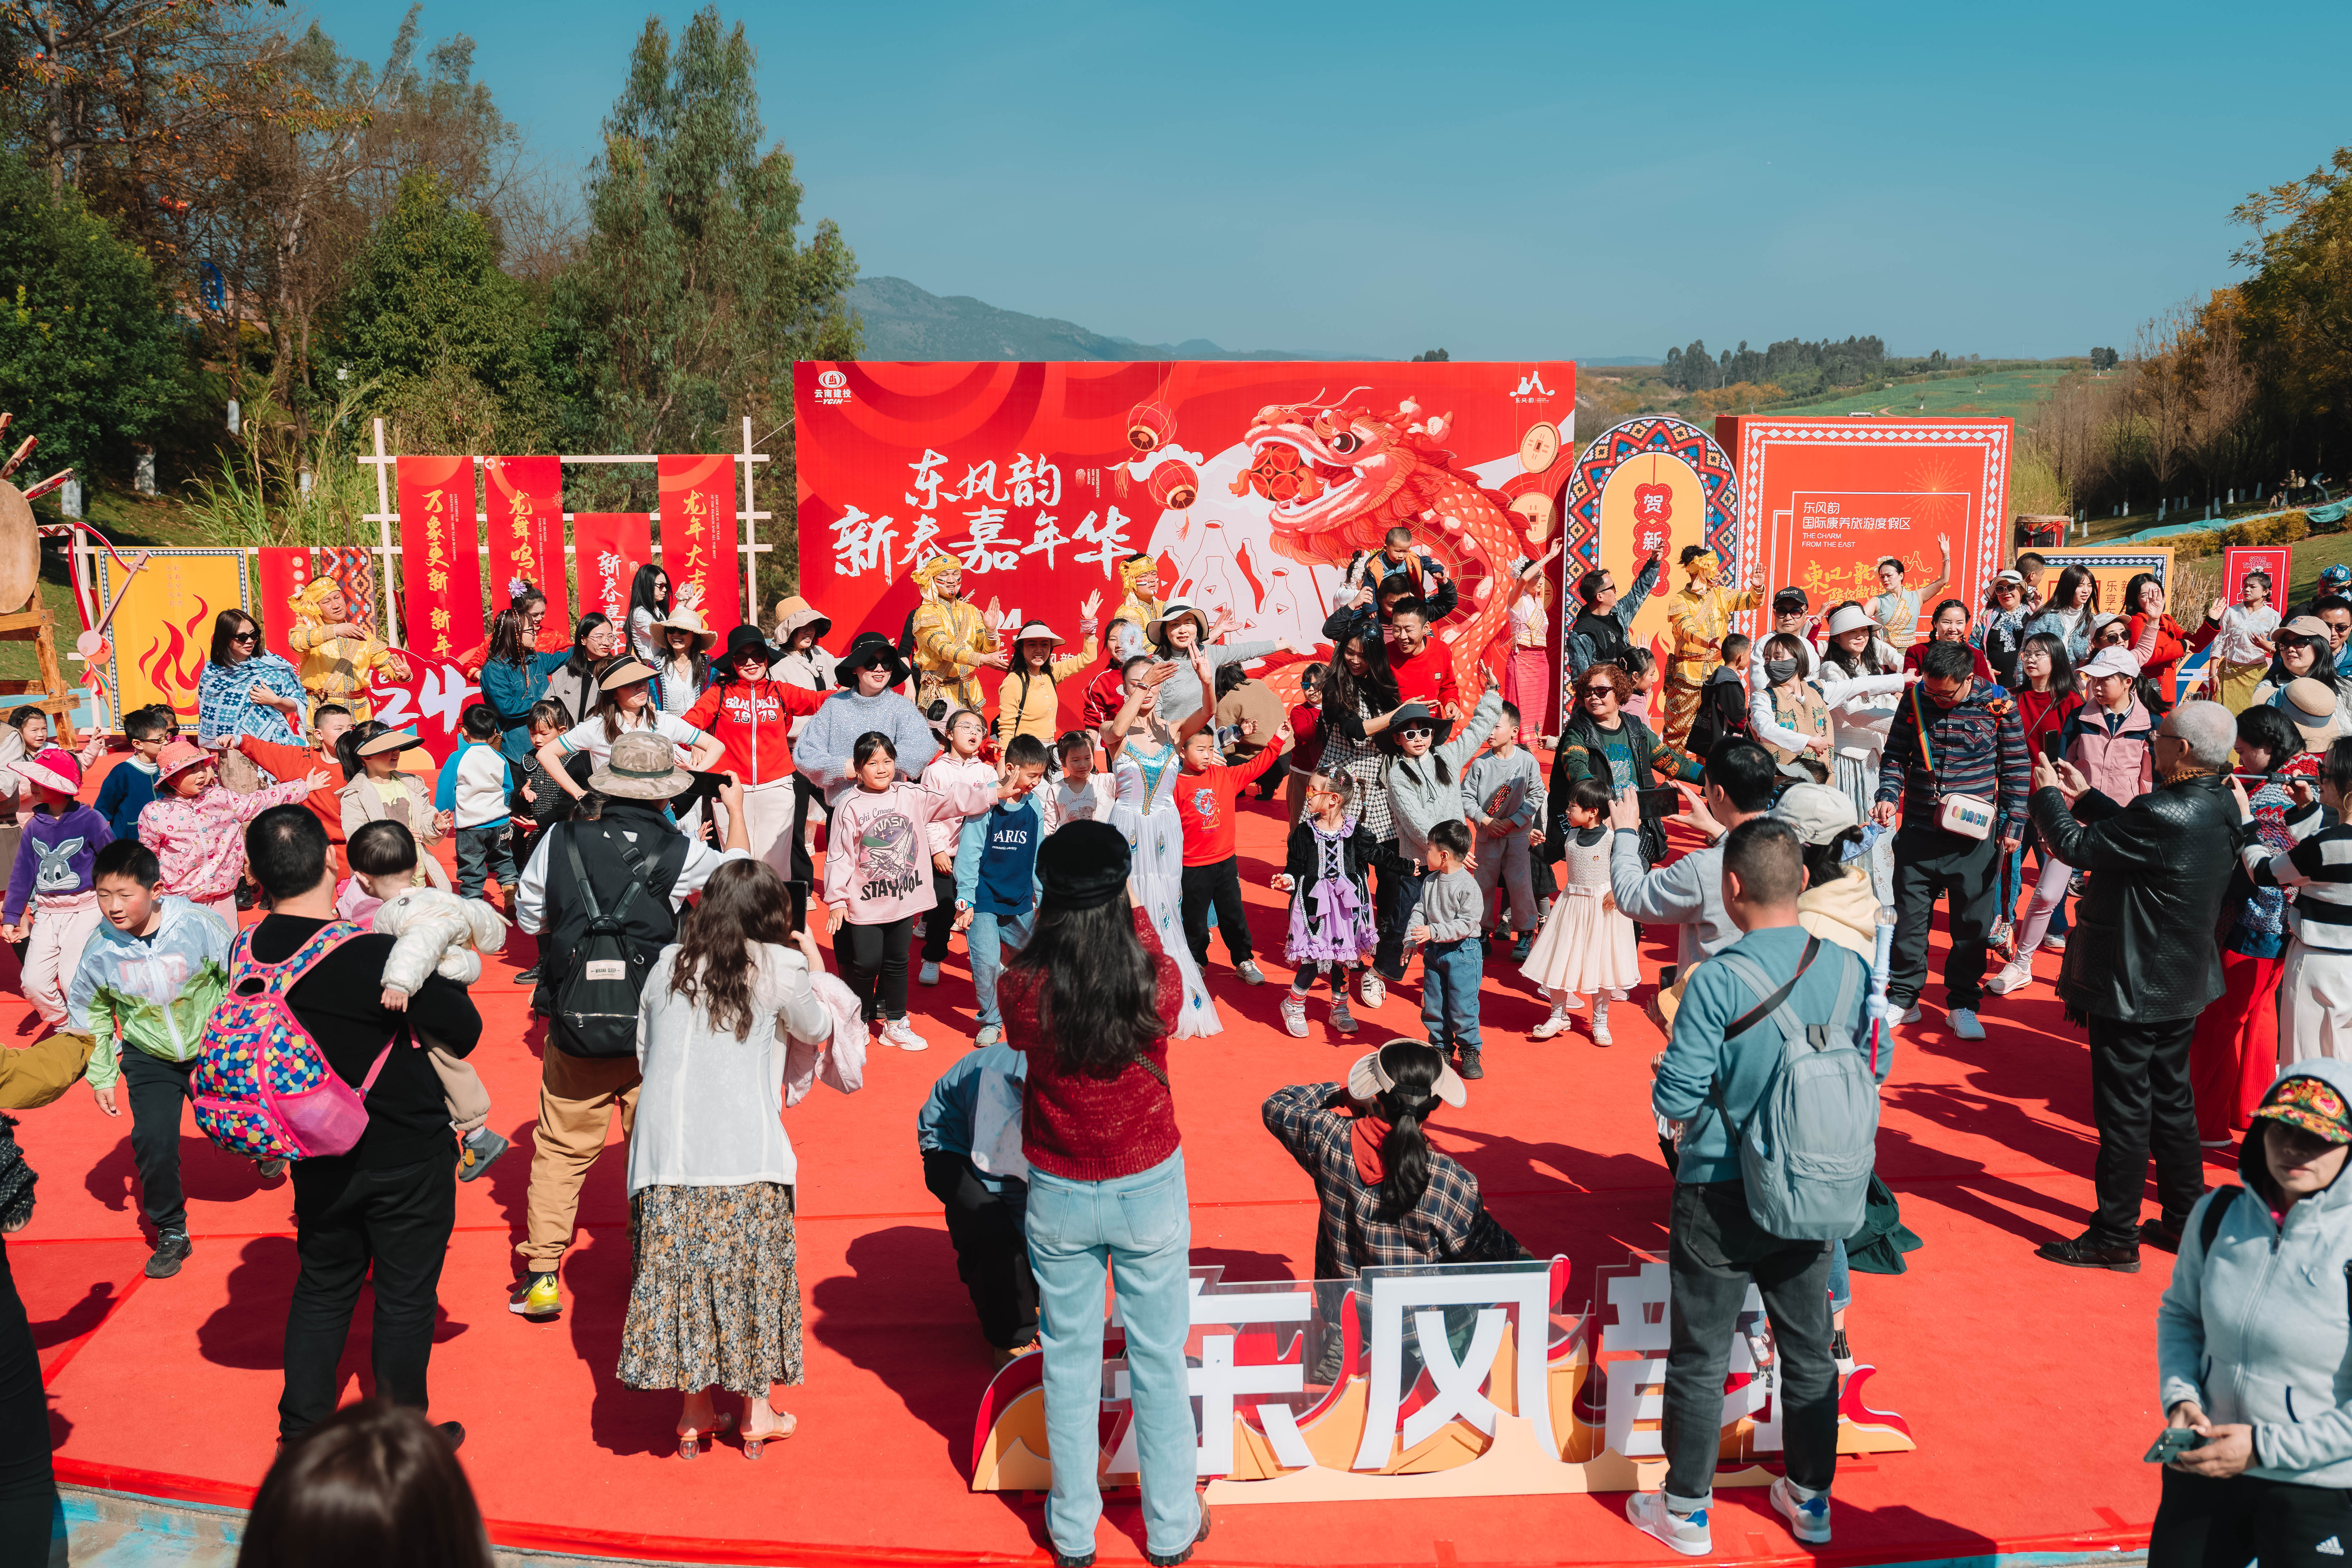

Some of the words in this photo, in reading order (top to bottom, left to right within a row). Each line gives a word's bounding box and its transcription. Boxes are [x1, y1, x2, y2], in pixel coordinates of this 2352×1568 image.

[814, 389, 851, 398] 云南建投
[905, 449, 1061, 509] 东风韵
[1804, 502, 1840, 514] 东风韵
[1803, 516, 1911, 529] 国际康养旅游度假区
[422, 489, 450, 594] 万象更新
[683, 490, 709, 595] 龙年大吉
[829, 505, 1136, 586] 新春嘉年华
[874, 816, 906, 835] NASA
[1952, 805, 1988, 827] COACH
[860, 878, 899, 901] STAY
